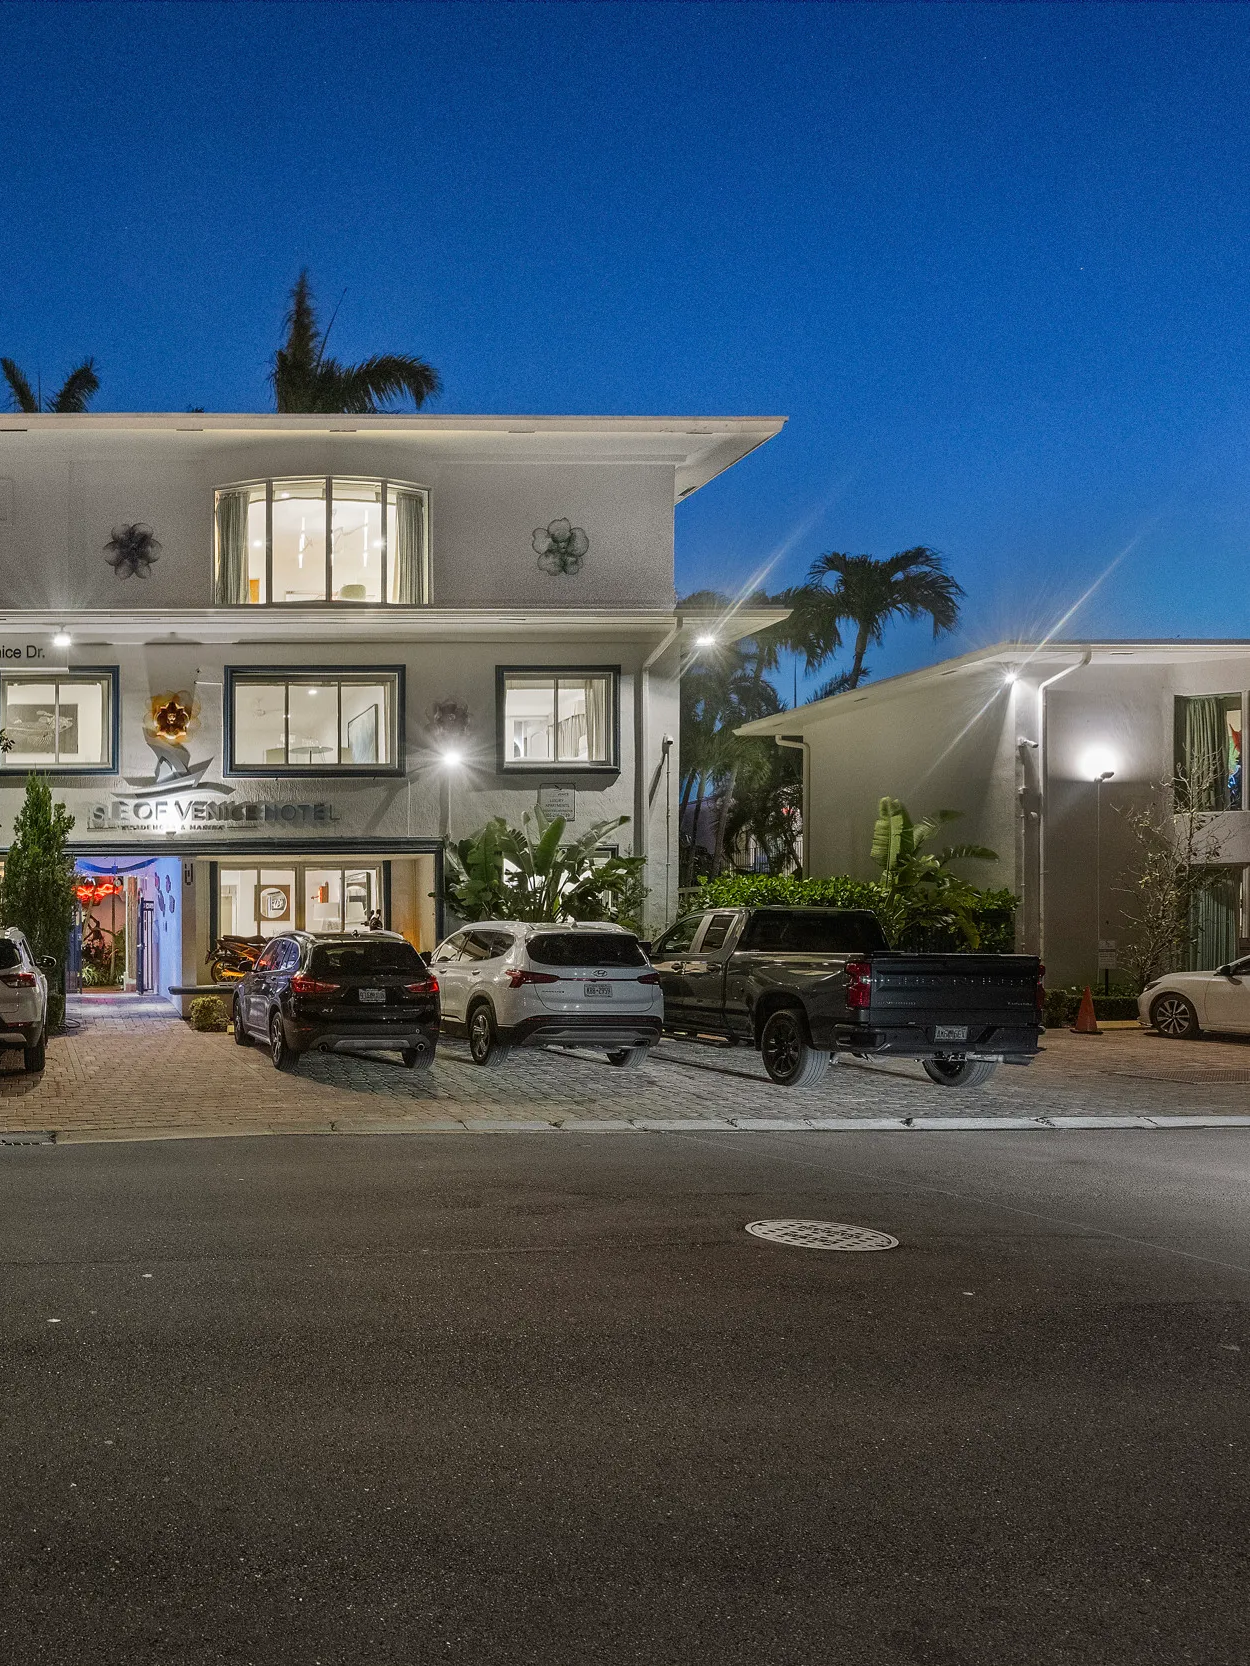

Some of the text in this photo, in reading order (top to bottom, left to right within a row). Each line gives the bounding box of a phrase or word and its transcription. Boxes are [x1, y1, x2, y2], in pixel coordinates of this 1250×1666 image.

[26, 645, 45, 658] Dr.
[133, 801, 168, 821] OF
[174, 800, 259, 821] VENICE
[264, 803, 341, 821] HOTEL
